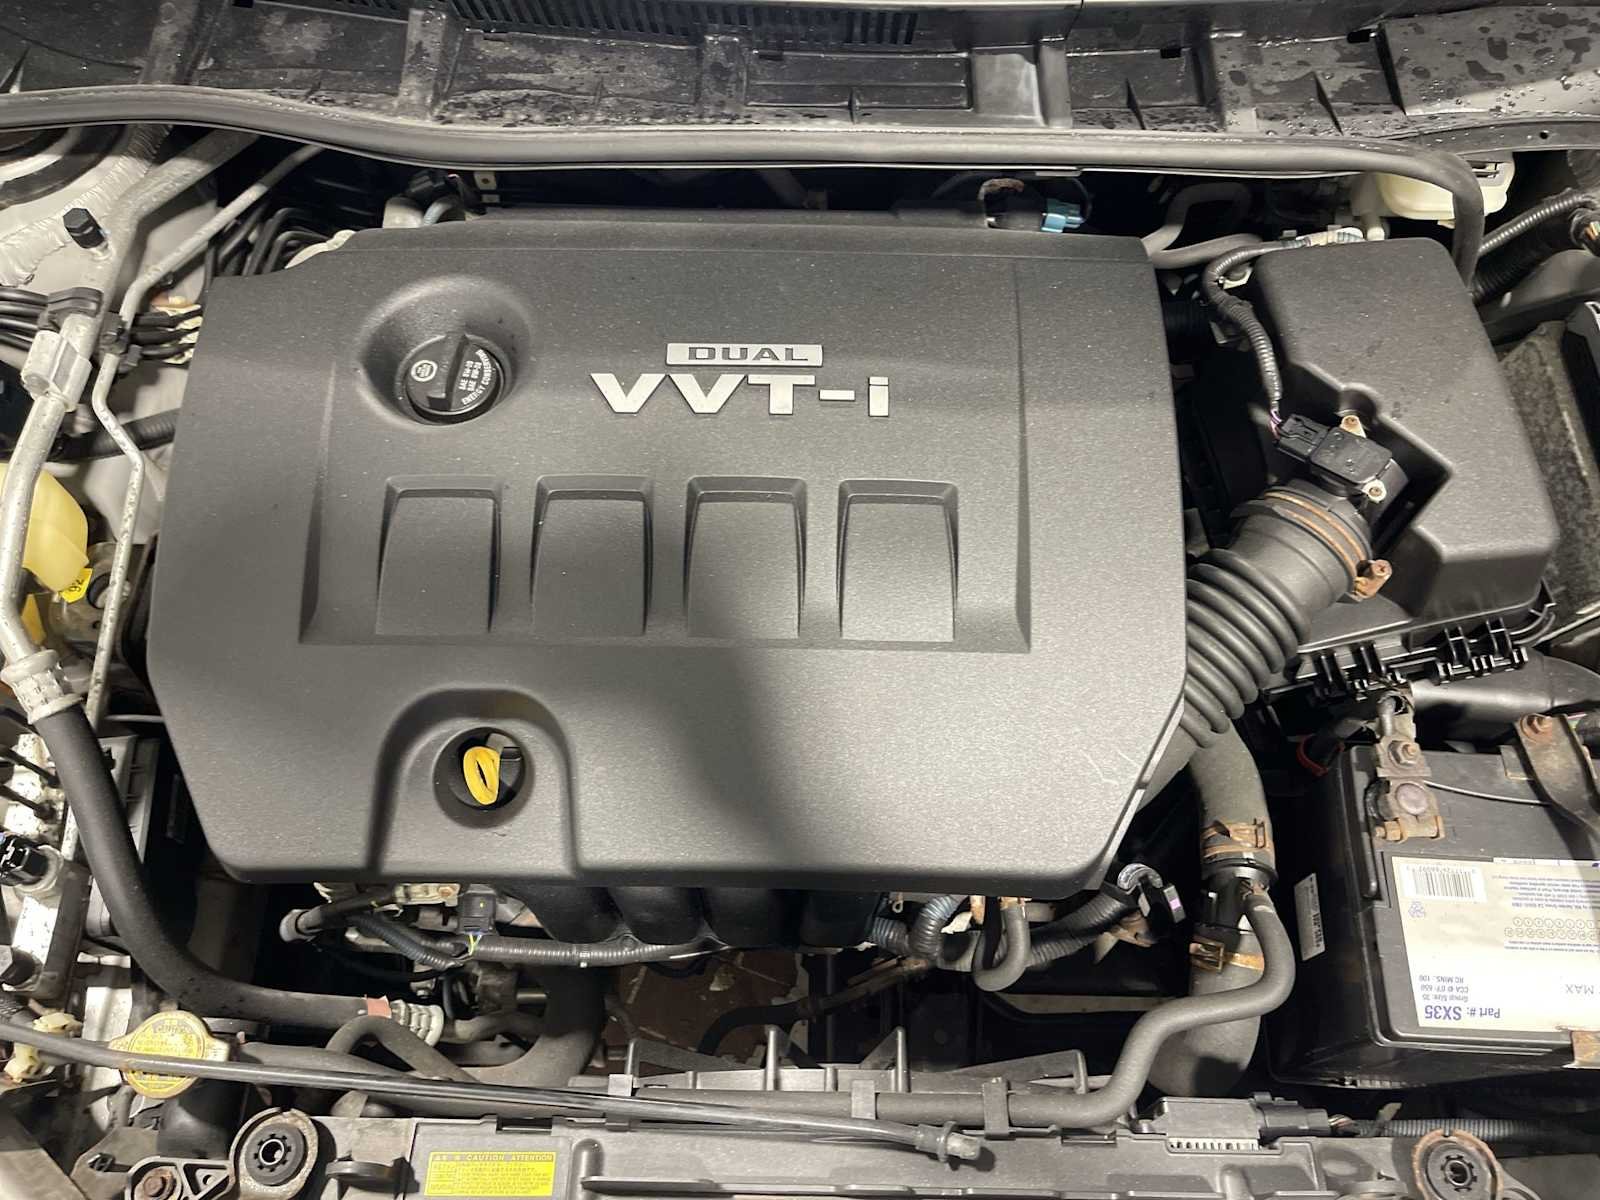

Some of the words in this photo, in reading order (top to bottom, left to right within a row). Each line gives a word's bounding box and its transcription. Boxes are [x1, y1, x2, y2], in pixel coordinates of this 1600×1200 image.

[687, 346, 809, 361] DUAL
[590, 373, 889, 417] VVT-i
[1565, 984, 1594, 994] MAX
[1424, 1005, 1462, 1021] SX35
[1479, 1006, 1501, 1019] Part
